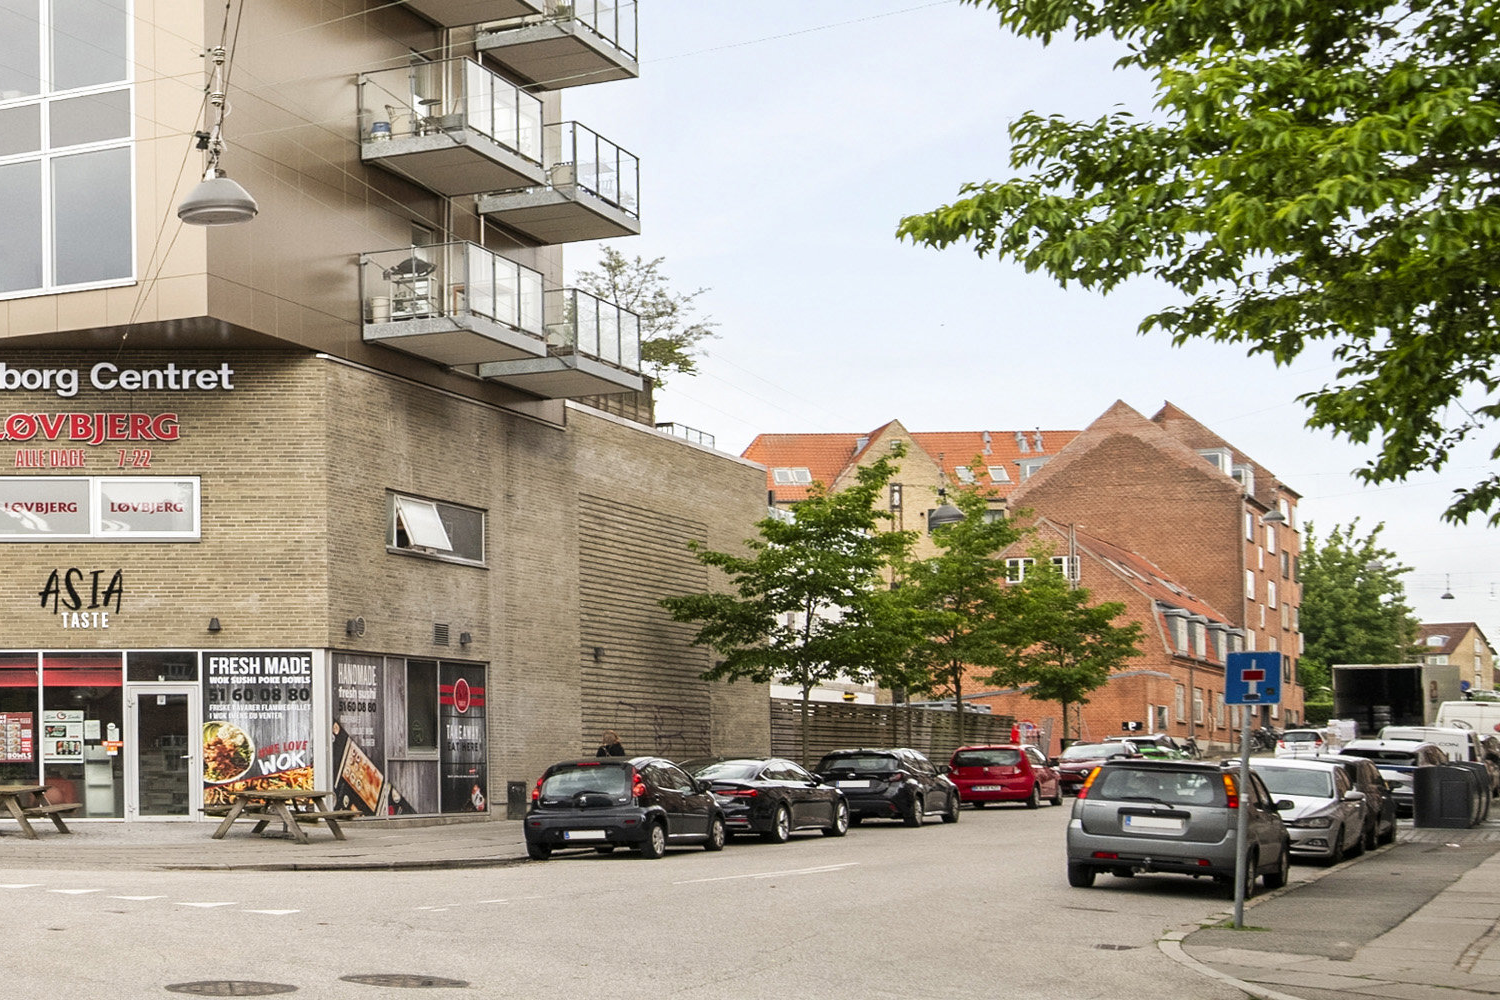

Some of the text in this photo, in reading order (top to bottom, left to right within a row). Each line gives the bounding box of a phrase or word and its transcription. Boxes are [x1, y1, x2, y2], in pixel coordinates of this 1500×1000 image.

[90, 362, 235, 390] Centret
[15, 449, 151, 468] ALLE DAGE 7-22
[4, 501, 78, 514] LØVBJERG
[110, 501, 184, 514] LØVBJERG
[38, 567, 124, 615] ASIA
[61, 612, 109, 629] TASTE
[209, 657, 311, 675] FRESH MADE
[209, 676, 311, 684] WOK SUSHI POKE BOWLS
[338, 663, 377, 686] HANDMADE
[209, 688, 310, 701] 51 60 08 80
[338, 685, 376, 699] fresh sushi
[367, 703, 377, 713] 80
[282, 740, 308, 752] LOVE
[257, 750, 306, 775] WOK
